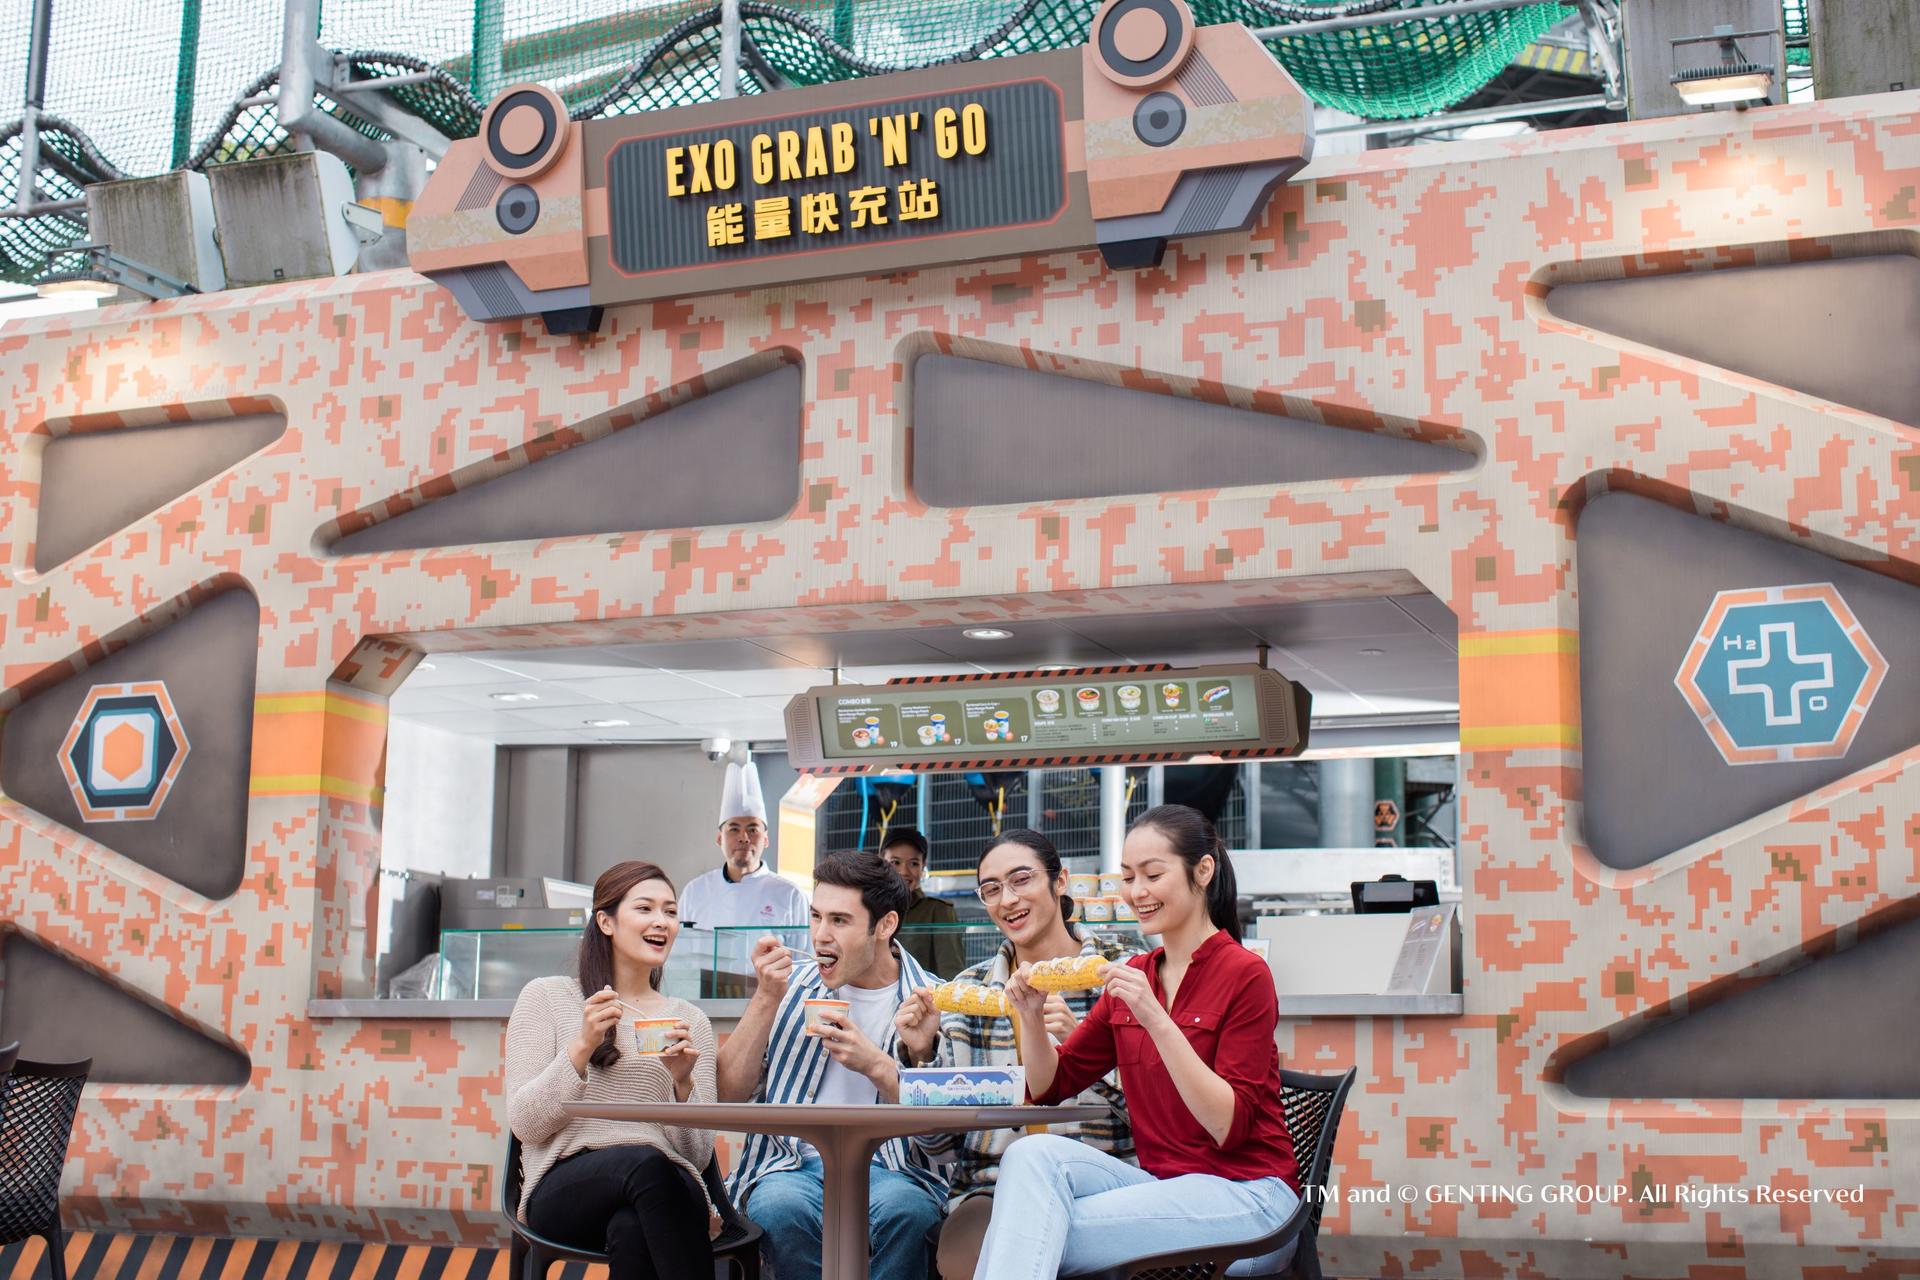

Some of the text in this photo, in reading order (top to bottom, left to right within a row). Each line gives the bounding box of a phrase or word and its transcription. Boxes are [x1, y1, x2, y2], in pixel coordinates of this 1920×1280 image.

[666, 103, 987, 197] EXO GRAB 'N' GO
[706, 178, 939, 248] 能量快充站
